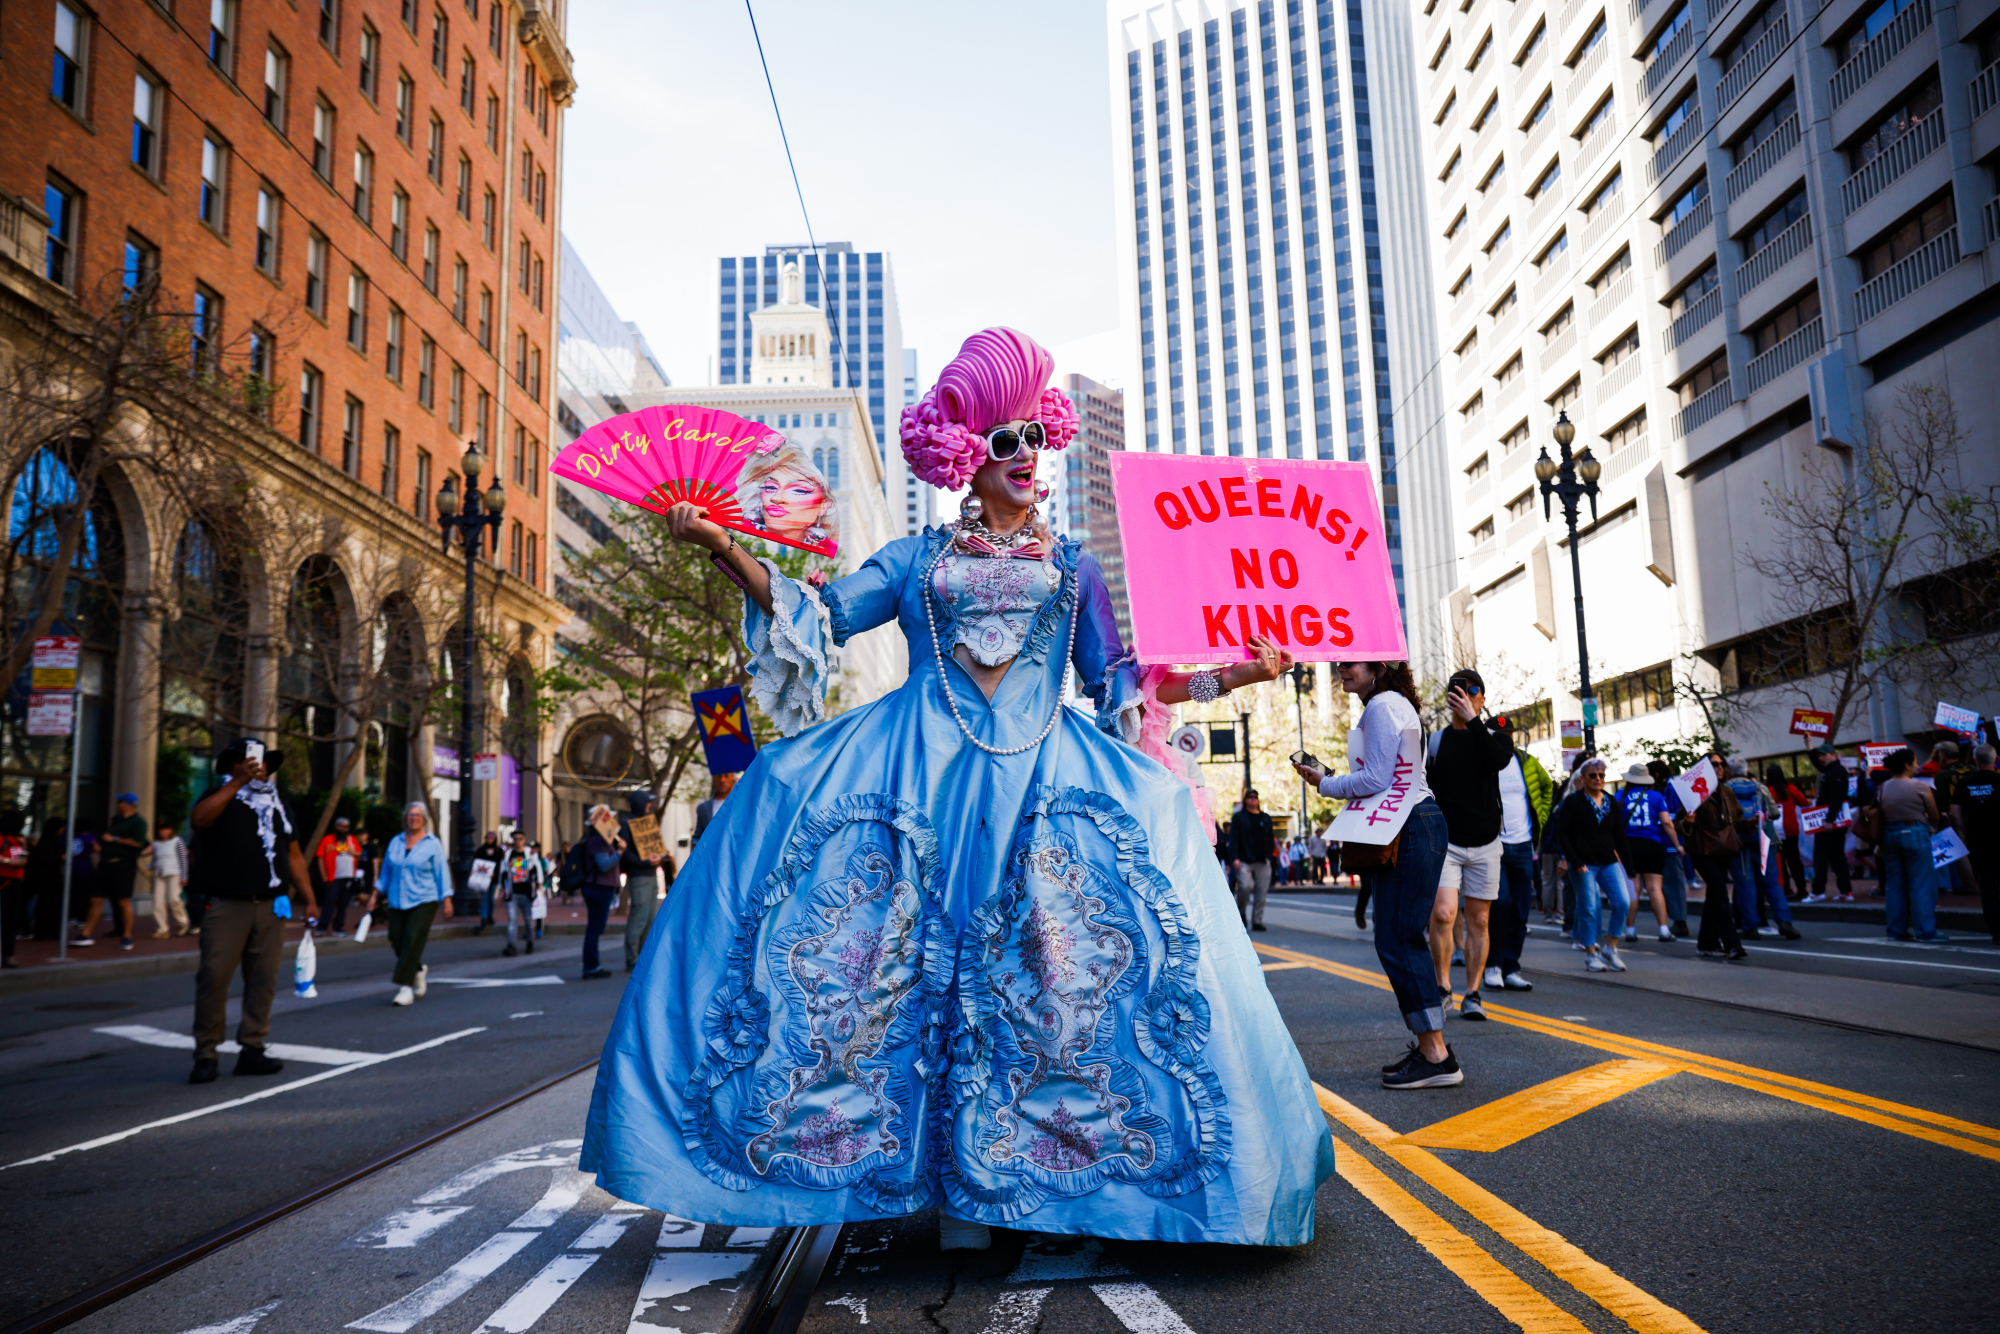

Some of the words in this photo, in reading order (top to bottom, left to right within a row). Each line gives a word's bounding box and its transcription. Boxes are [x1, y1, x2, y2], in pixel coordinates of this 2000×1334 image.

[576, 430, 651, 478] Dirty
[663, 418, 756, 453] Carol
[1154, 476, 1369, 561] QUEENS!
[1230, 548, 1299, 590] NO
[1202, 604, 1354, 648] KINGS
[1794, 721, 1829, 734] PALANTIR
[1366, 754, 1413, 826] TRUMP
[1627, 801, 1651, 827] 21
